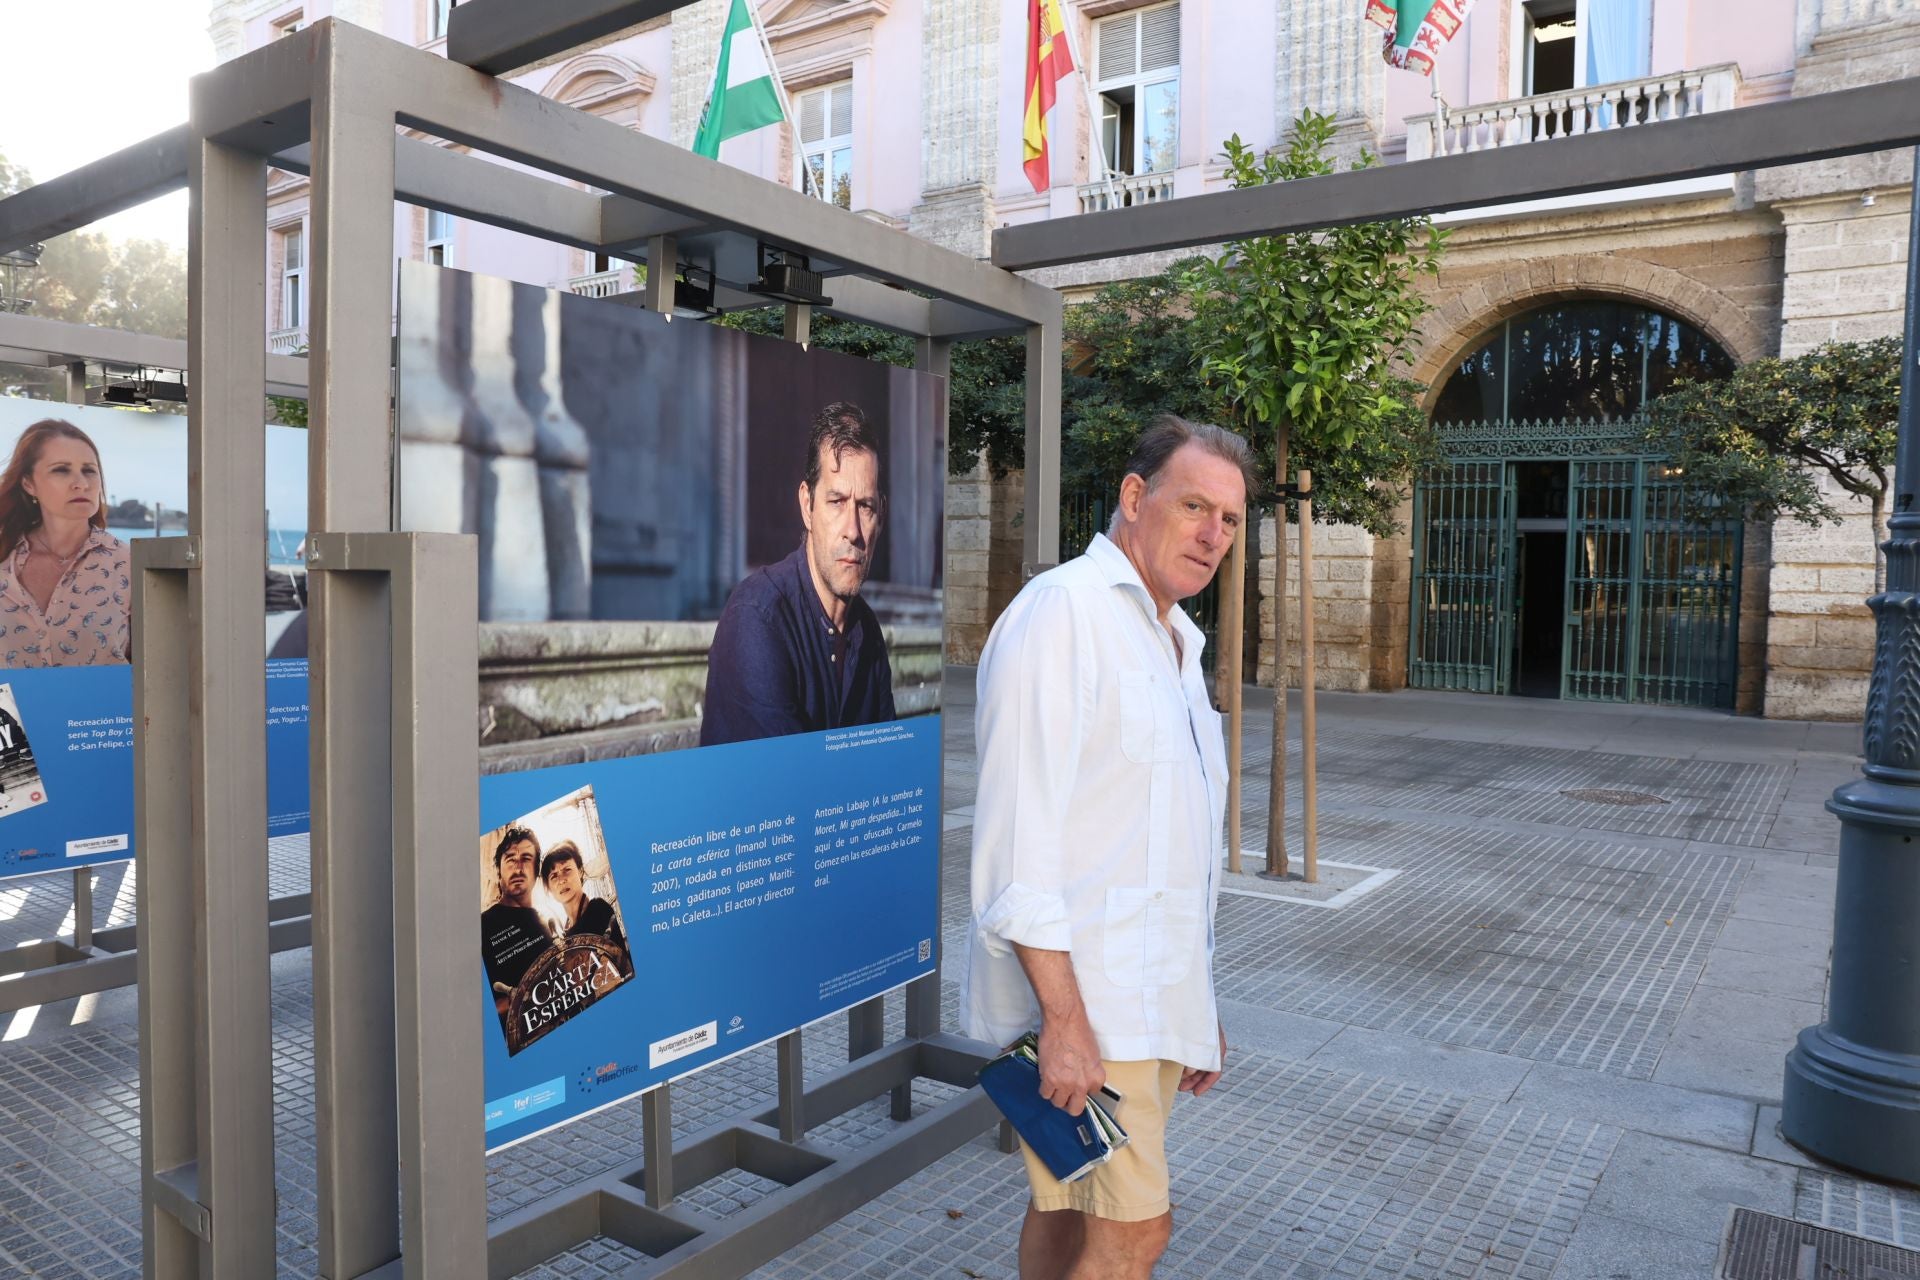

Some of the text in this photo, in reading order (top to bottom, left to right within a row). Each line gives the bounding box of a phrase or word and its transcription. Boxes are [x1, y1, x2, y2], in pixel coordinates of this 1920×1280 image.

[68, 718, 114, 727] Recreación
[68, 730, 88, 739] serie
[92, 730, 106, 738] Top
[108, 728, 123, 737] Boy
[81, 742, 96, 750] San
[98, 740, 125, 749] Felipe,
[815, 805, 843, 819] Antonio
[847, 800, 869, 812] Labajo
[882, 794, 888, 804] la
[891, 789, 913, 802] sombra
[916, 786, 923, 796] de
[651, 814, 795, 854] Recreación libre de un plano de
[815, 824, 836, 836] Moret,
[840, 820, 848, 830] Mi
[850, 818, 866, 830] gran
[909, 804, 922, 814] hace
[815, 818, 922, 854] aquí de un ofuscado Carmelo
[652, 833, 795, 874] La carta esférica (Imanol Uribe,
[815, 835, 922, 870] Gómez en las escaleras de la Cate-
[651, 851, 795, 894] 2007), rodada en distintos esce-
[815, 874, 830, 887] dral.
[652, 898, 680, 913] narios
[687, 885, 731, 907] gaditanos
[737, 877, 764, 893] (paseo
[652, 921, 670, 933] mo,
[672, 917, 680, 927] la
[725, 902, 732, 913] El
[734, 896, 755, 910] actor
[755, 896, 762, 906] y
[764, 886, 795, 901] director
[532, 951, 603, 1006] CARTA
[549, 967, 562, 980] LA
[658, 1038, 687, 1054] Ayuntamiento
[695, 1030, 707, 1039] Cádiz
[596, 1062, 616, 1076] Cádiz
[596, 1064, 638, 1085] FilmOffice
